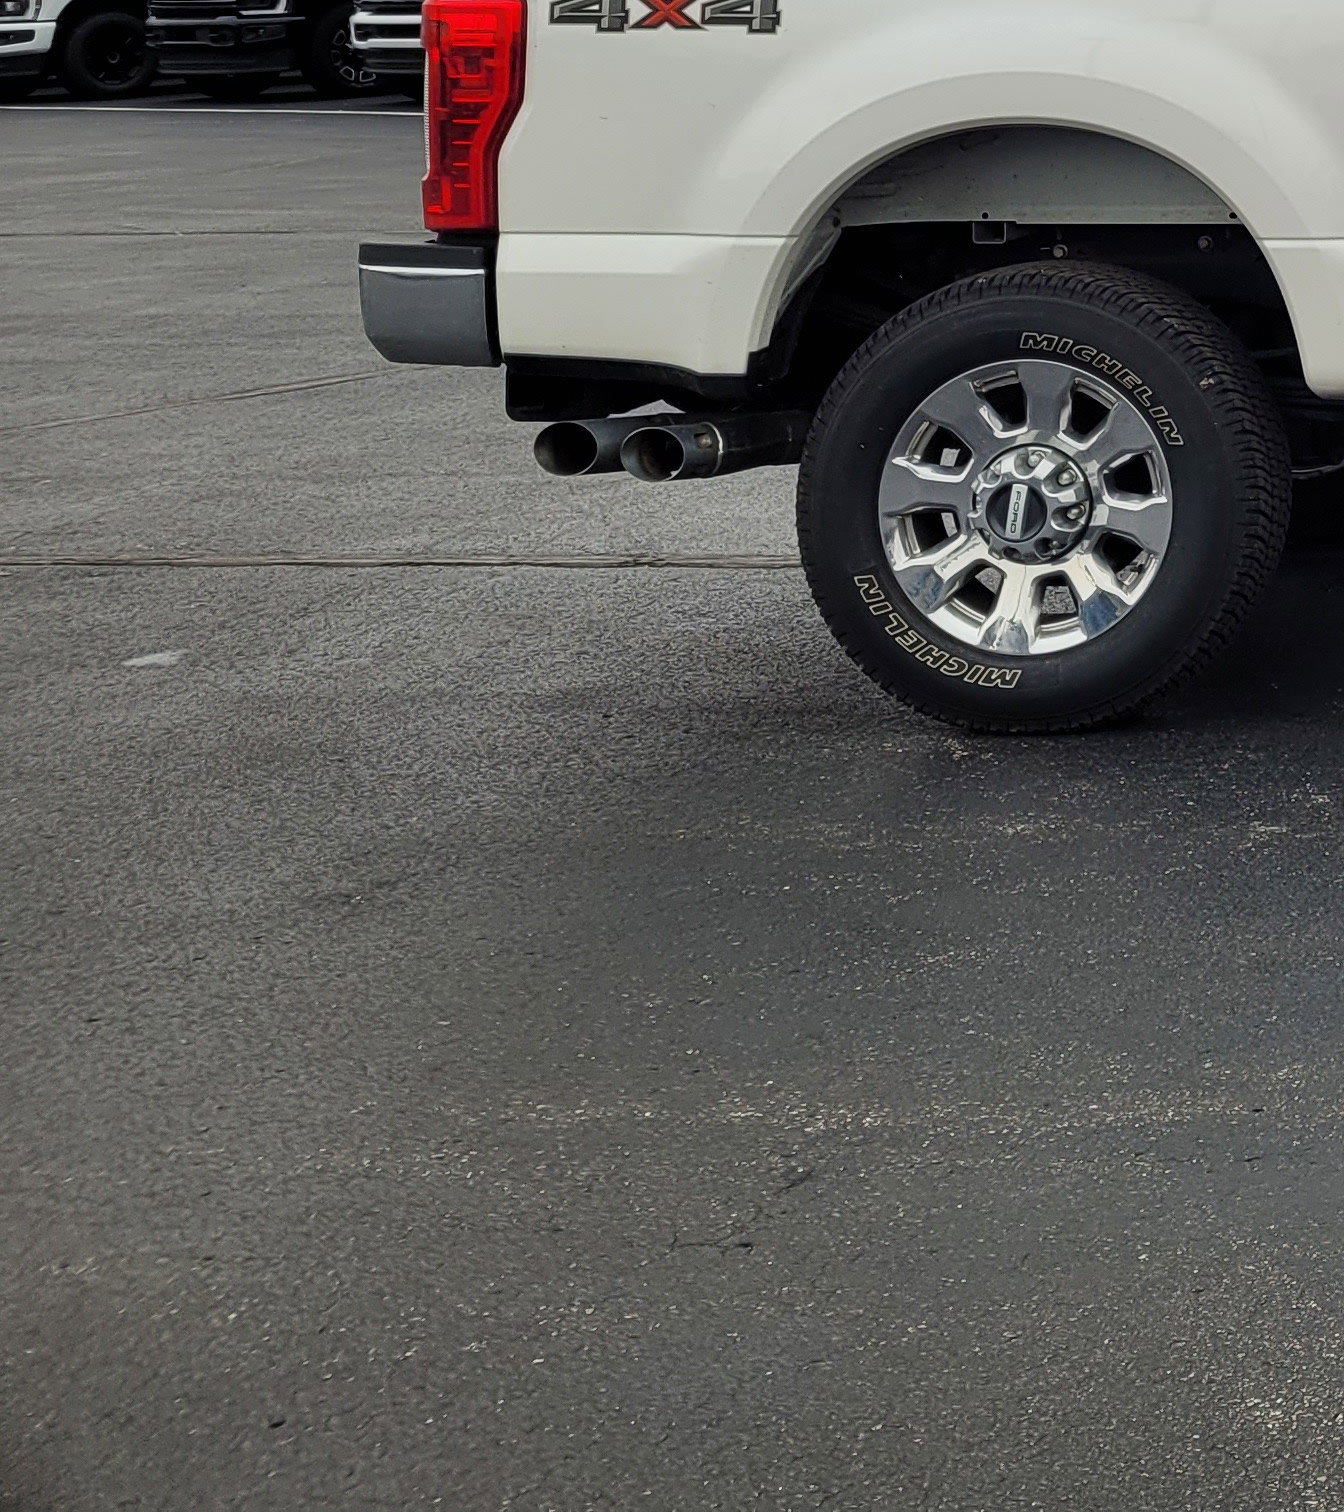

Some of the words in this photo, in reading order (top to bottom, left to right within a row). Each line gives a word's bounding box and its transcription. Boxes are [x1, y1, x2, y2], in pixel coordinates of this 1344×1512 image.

[1019, 332, 1185, 446] MICHELIN
[1010, 490, 1021, 534] FORD
[853, 574, 1022, 689] MICHELIN
